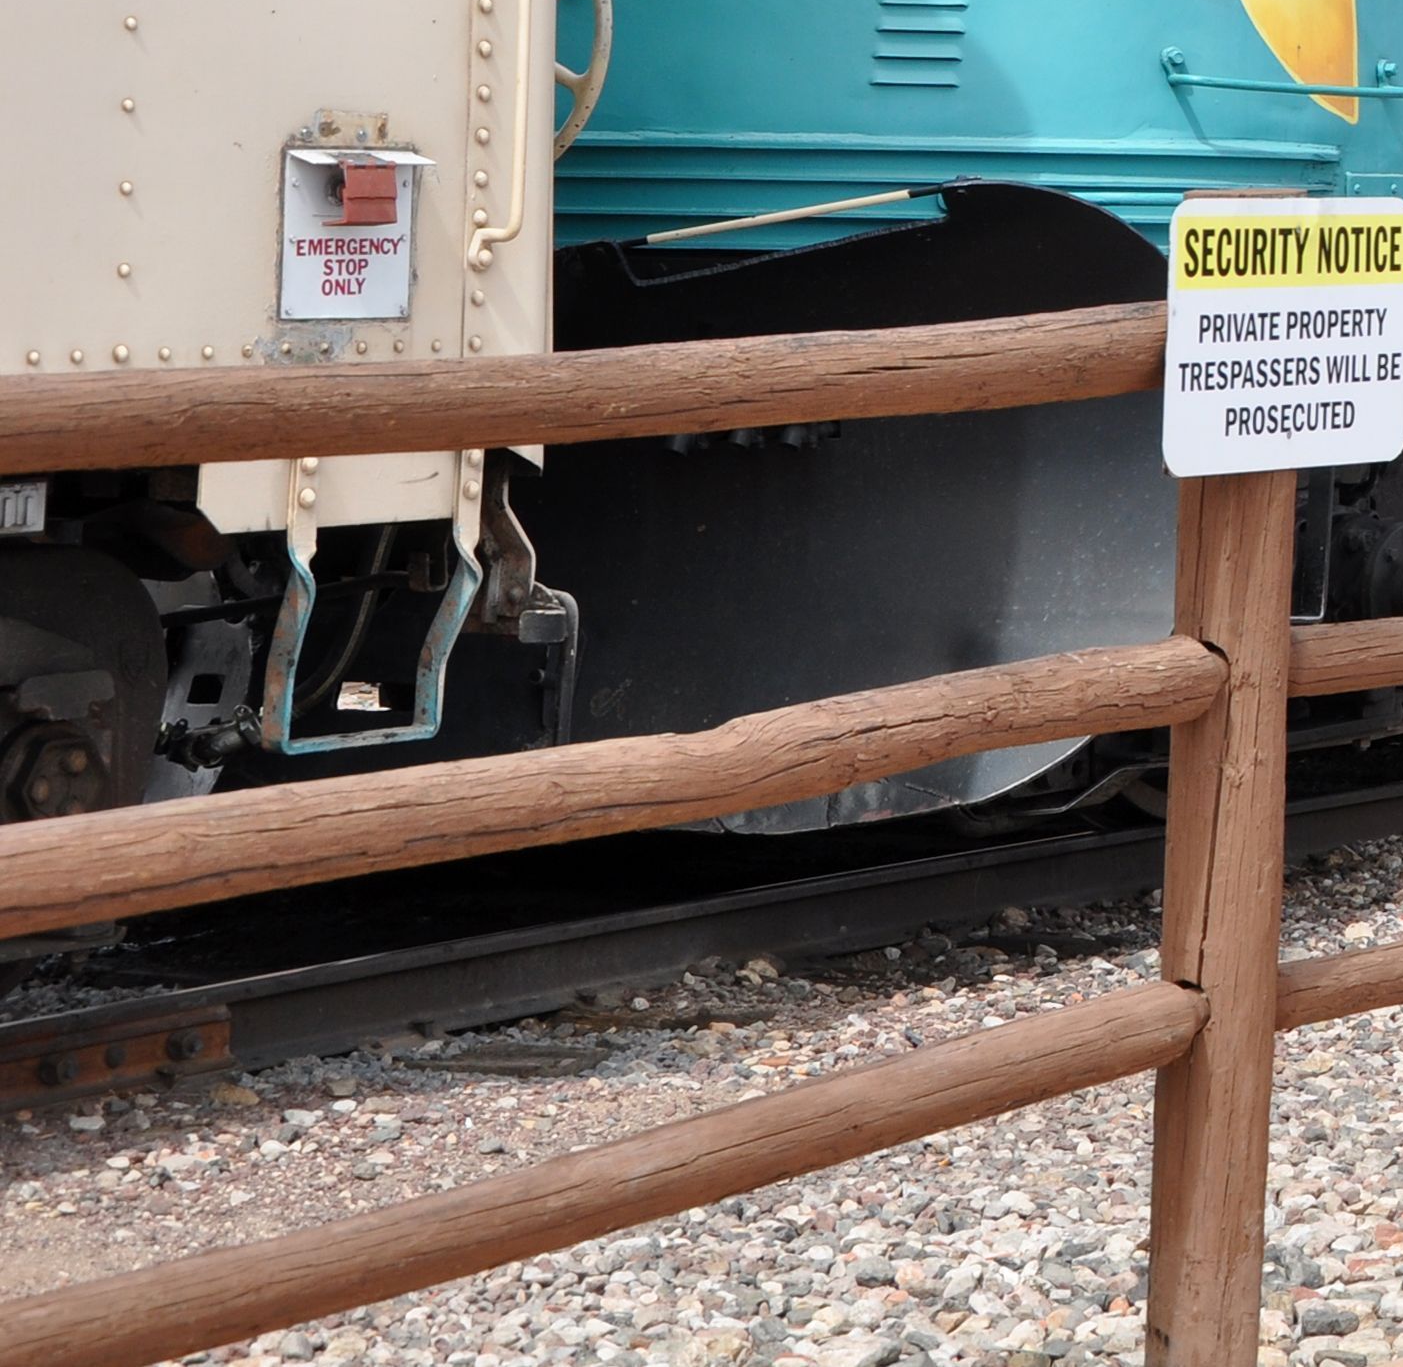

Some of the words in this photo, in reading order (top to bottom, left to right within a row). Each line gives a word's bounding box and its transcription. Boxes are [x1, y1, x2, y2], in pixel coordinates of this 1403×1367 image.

[296, 238, 401, 256] EMERGENCY
[1184, 227, 1310, 278] SECURITY
[1317, 226, 1402, 274] NOTICE
[323, 259, 369, 276] STOP
[321, 278, 367, 296] ONLY
[1199, 312, 1281, 344] PRIVATE
[1286, 308, 1387, 340] PROPERTY
[1179, 356, 1320, 392] TRESPASSERS
[1326, 354, 1371, 384] WILL
[1377, 353, 1402, 382] BE
[1225, 401, 1355, 437] PROSECUTED
